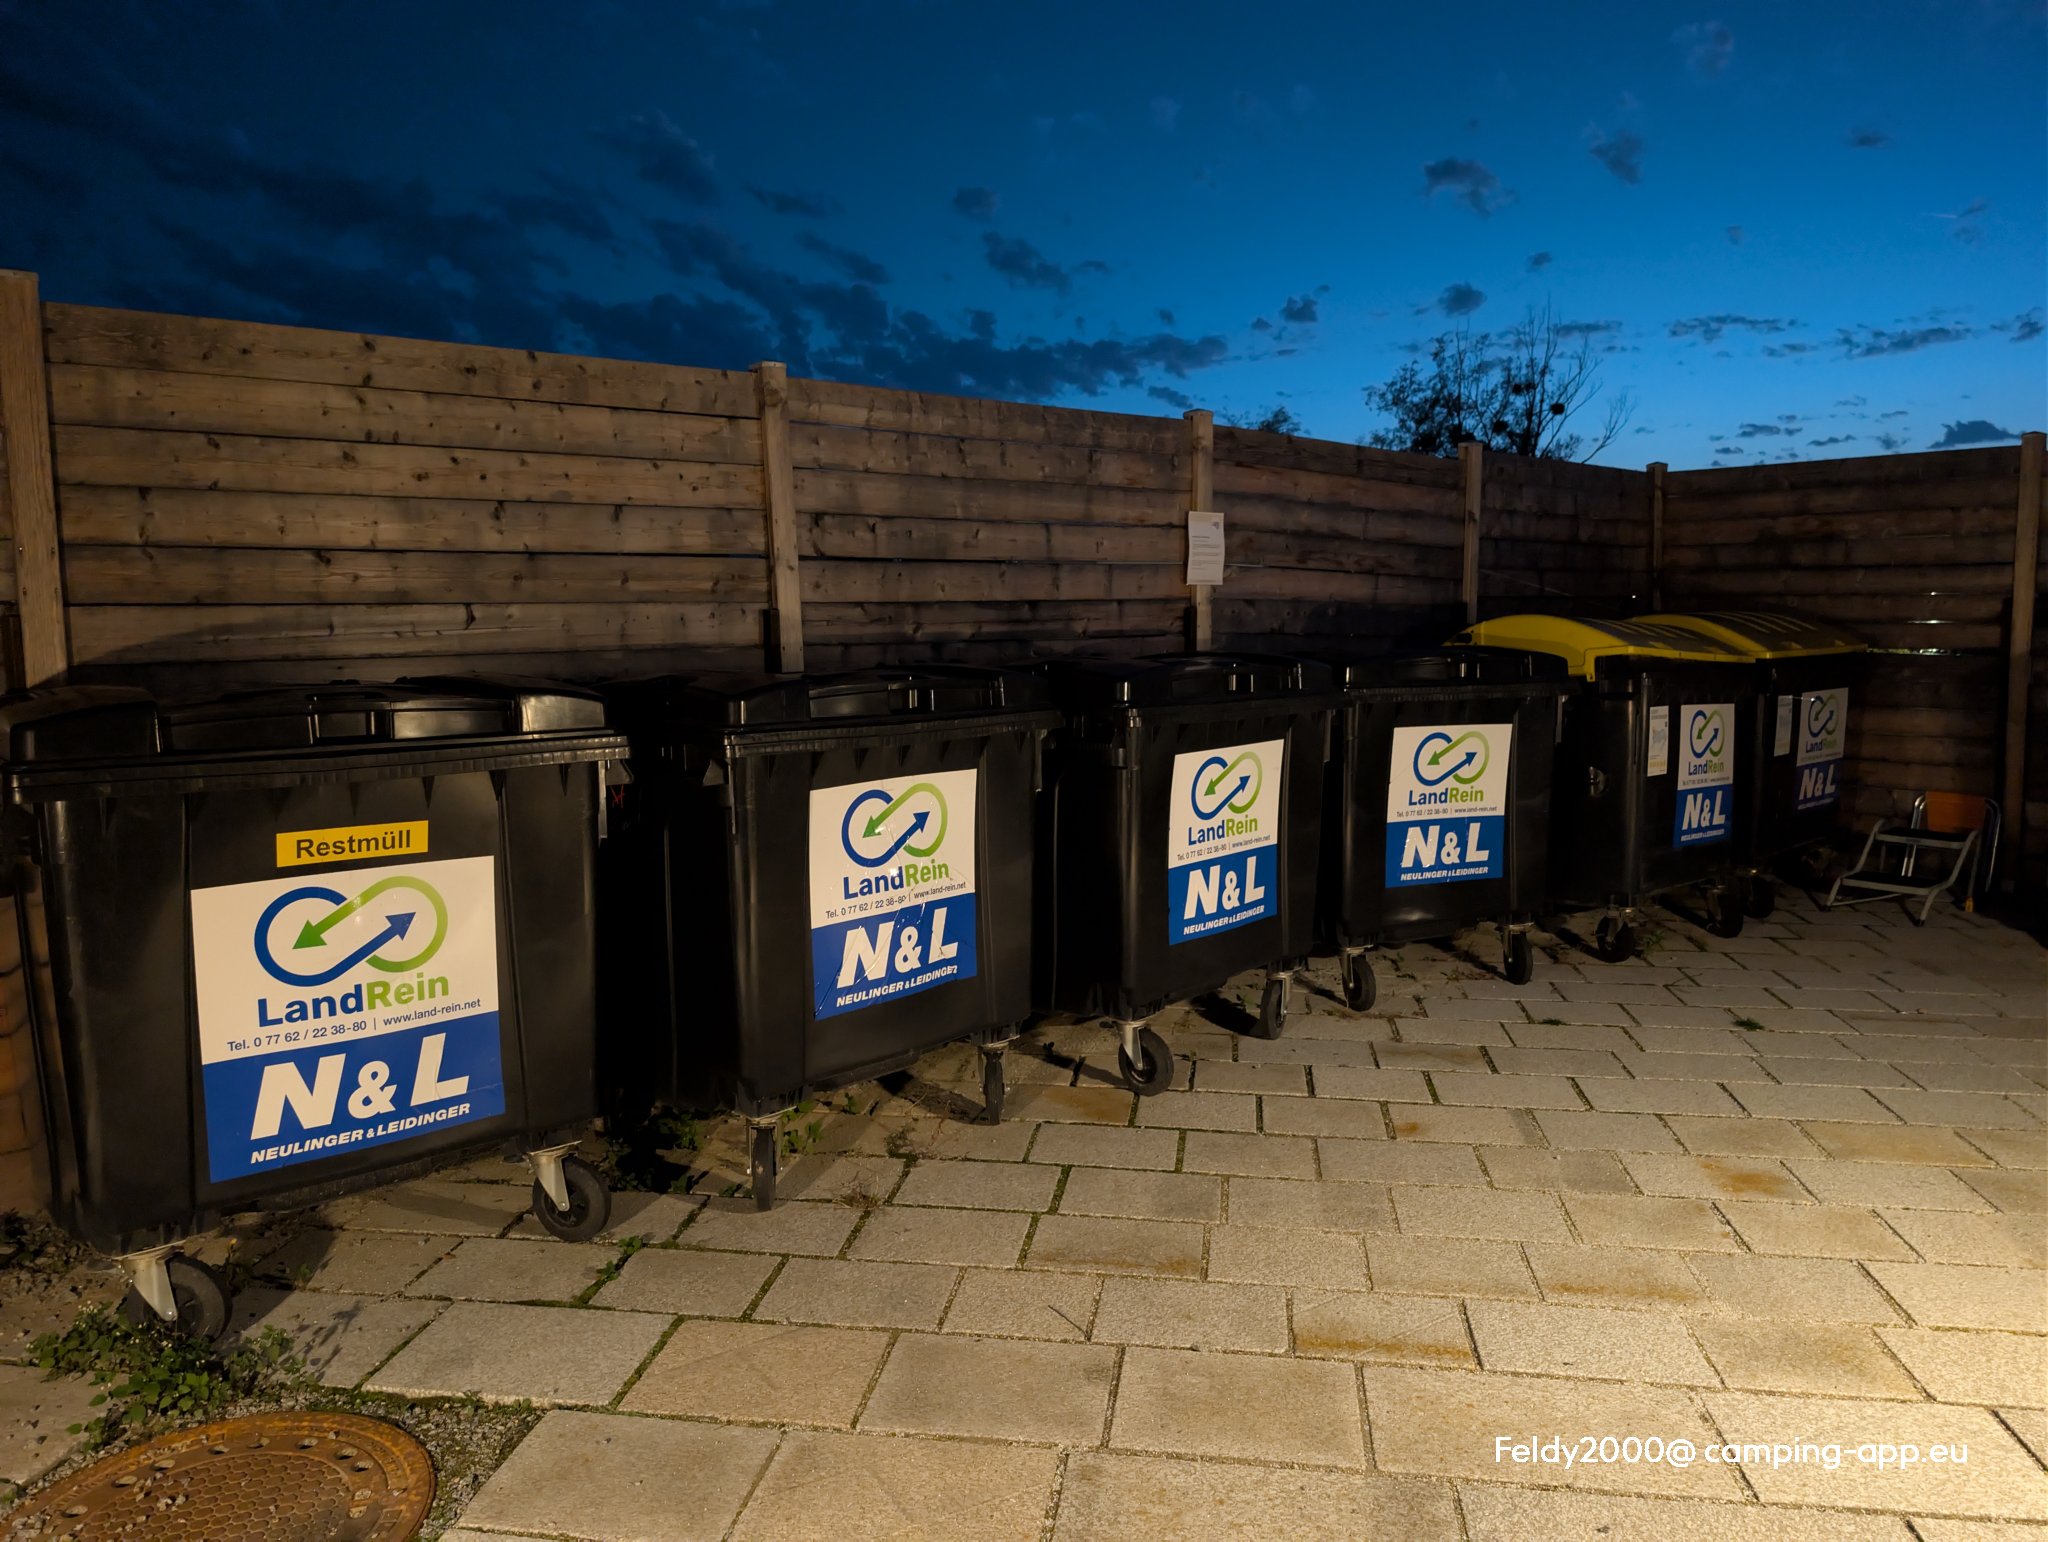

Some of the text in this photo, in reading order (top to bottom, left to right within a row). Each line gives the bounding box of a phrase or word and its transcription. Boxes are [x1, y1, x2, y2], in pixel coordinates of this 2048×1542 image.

[1688, 759, 1725, 776] LandRein
[1408, 786, 1484, 806] LandRein
[296, 830, 411, 859] Restmüll
[1188, 815, 1258, 846] LandRein
[843, 859, 949, 900] LandRein
[1401, 870, 1447, 881] NEULINGER
[826, 909, 839, 919] Tel.
[841, 907, 846, 916] 0
[848, 904, 857, 914] 77
[859, 902, 869, 912] 62
[875, 899, 884, 909] 22
[885, 895, 907, 906] 38-80
[914, 881, 966, 899] www.land-rein.net
[1183, 917, 1228, 936] NEULINGER
[258, 972, 449, 1028] LandRein
[836, 981, 903, 1008] NEULINGER
[227, 1039, 250, 1052] Tel.
[254, 1037, 262, 1048] 0
[266, 1034, 280, 1046] 77
[284, 1031, 300, 1043] 62
[312, 1027, 327, 1038] 22
[331, 1020, 367, 1035] 38-80
[383, 998, 481, 1026] www.land-rein.net
[251, 1128, 363, 1165] NEULINGER
[376, 1103, 470, 1137] LEIDINGER
